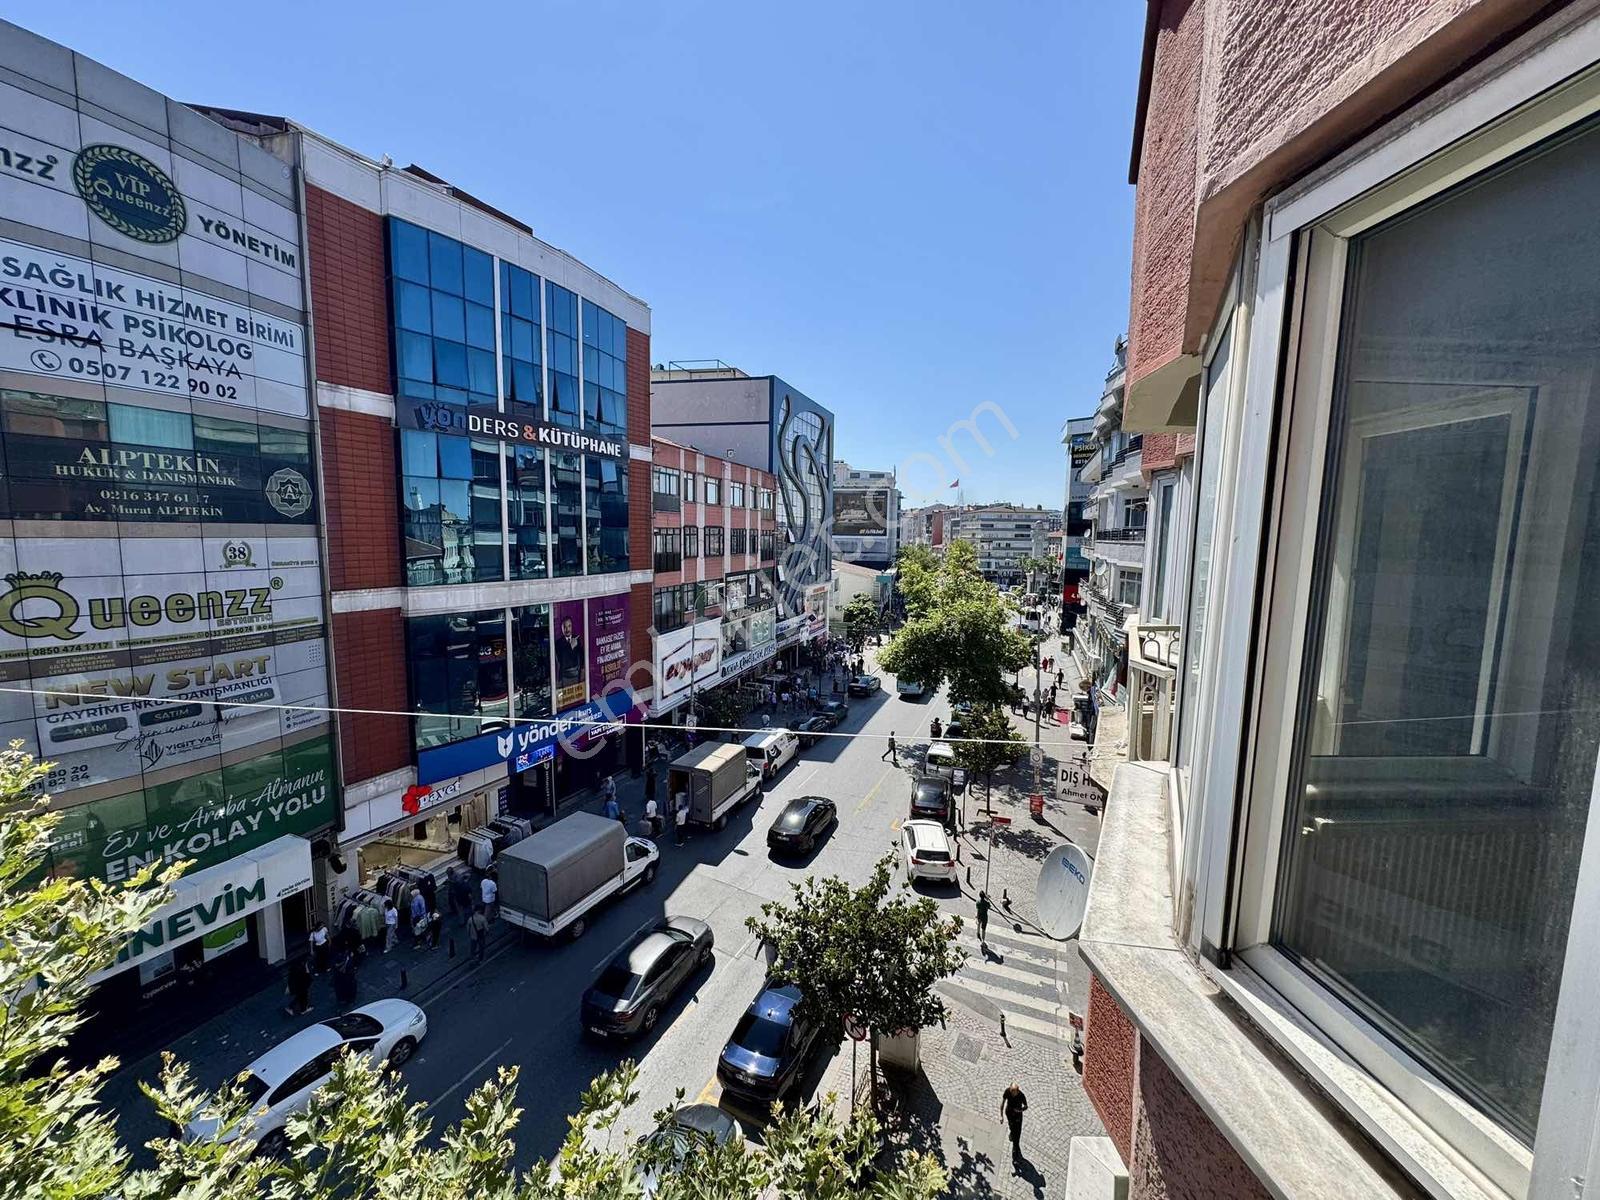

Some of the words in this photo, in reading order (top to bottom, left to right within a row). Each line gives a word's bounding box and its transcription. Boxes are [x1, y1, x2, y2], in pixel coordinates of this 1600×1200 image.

[93, 177, 171, 217] Queenzz
[197, 214, 296, 268] YÖNETİM
[2, 256, 125, 303] SAĞLIK
[136, 288, 229, 329] HİZMET
[236, 317, 295, 348] BİRİMİ
[13, 314, 107, 352] ESRA
[119, 338, 243, 381] BAŞKAYA
[124, 314, 253, 360] PSİKOLOG
[68, 357, 131, 381] 0507
[140, 368, 180, 390] 122
[187, 378, 210, 396] 90
[215, 381, 238, 400] 02
[469, 415, 518, 438] DERS
[523, 424, 536, 441] &
[538, 427, 621, 457] KÜTÜPHANE
[55, 464, 119, 479] HUKUK
[124, 469, 137, 481] &
[142, 470, 237, 487] DANIŞMANLIK
[77, 446, 220, 474] ALPTEKİN
[84, 504, 105, 514] Av.
[111, 504, 151, 516] Murat
[157, 504, 224, 517] ALPTEKİN
[100, 489, 139, 501] 0216
[143, 490, 171, 502] 347
[174, 492, 190, 503] 61
[228, 546, 247, 560] 38
[0, 585, 272, 641] Queenzz
[32, 647, 60, 657] 0850
[62, 644, 82, 654] 474
[86, 642, 109, 651] 1717
[45, 673, 154, 710] NEW
[167, 655, 272, 691] START
[154, 706, 190, 720] SATIM
[518, 715, 575, 752] yönder
[48, 769, 67, 779] 80
[71, 764, 88, 774] 20
[48, 777, 66, 787] 82
[71, 772, 90, 782] 84
[1061, 767, 1079, 787] DİŞ
[418, 780, 461, 808] payet
[1061, 787, 1088, 799] Ahmet
[102, 829, 139, 857] Ev
[146, 822, 172, 842] ve
[178, 795, 246, 832] Araba
[251, 769, 325, 806] Almanın
[106, 850, 154, 883] EN
[162, 811, 266, 864] KOLAY
[267, 785, 327, 822] YOLU
